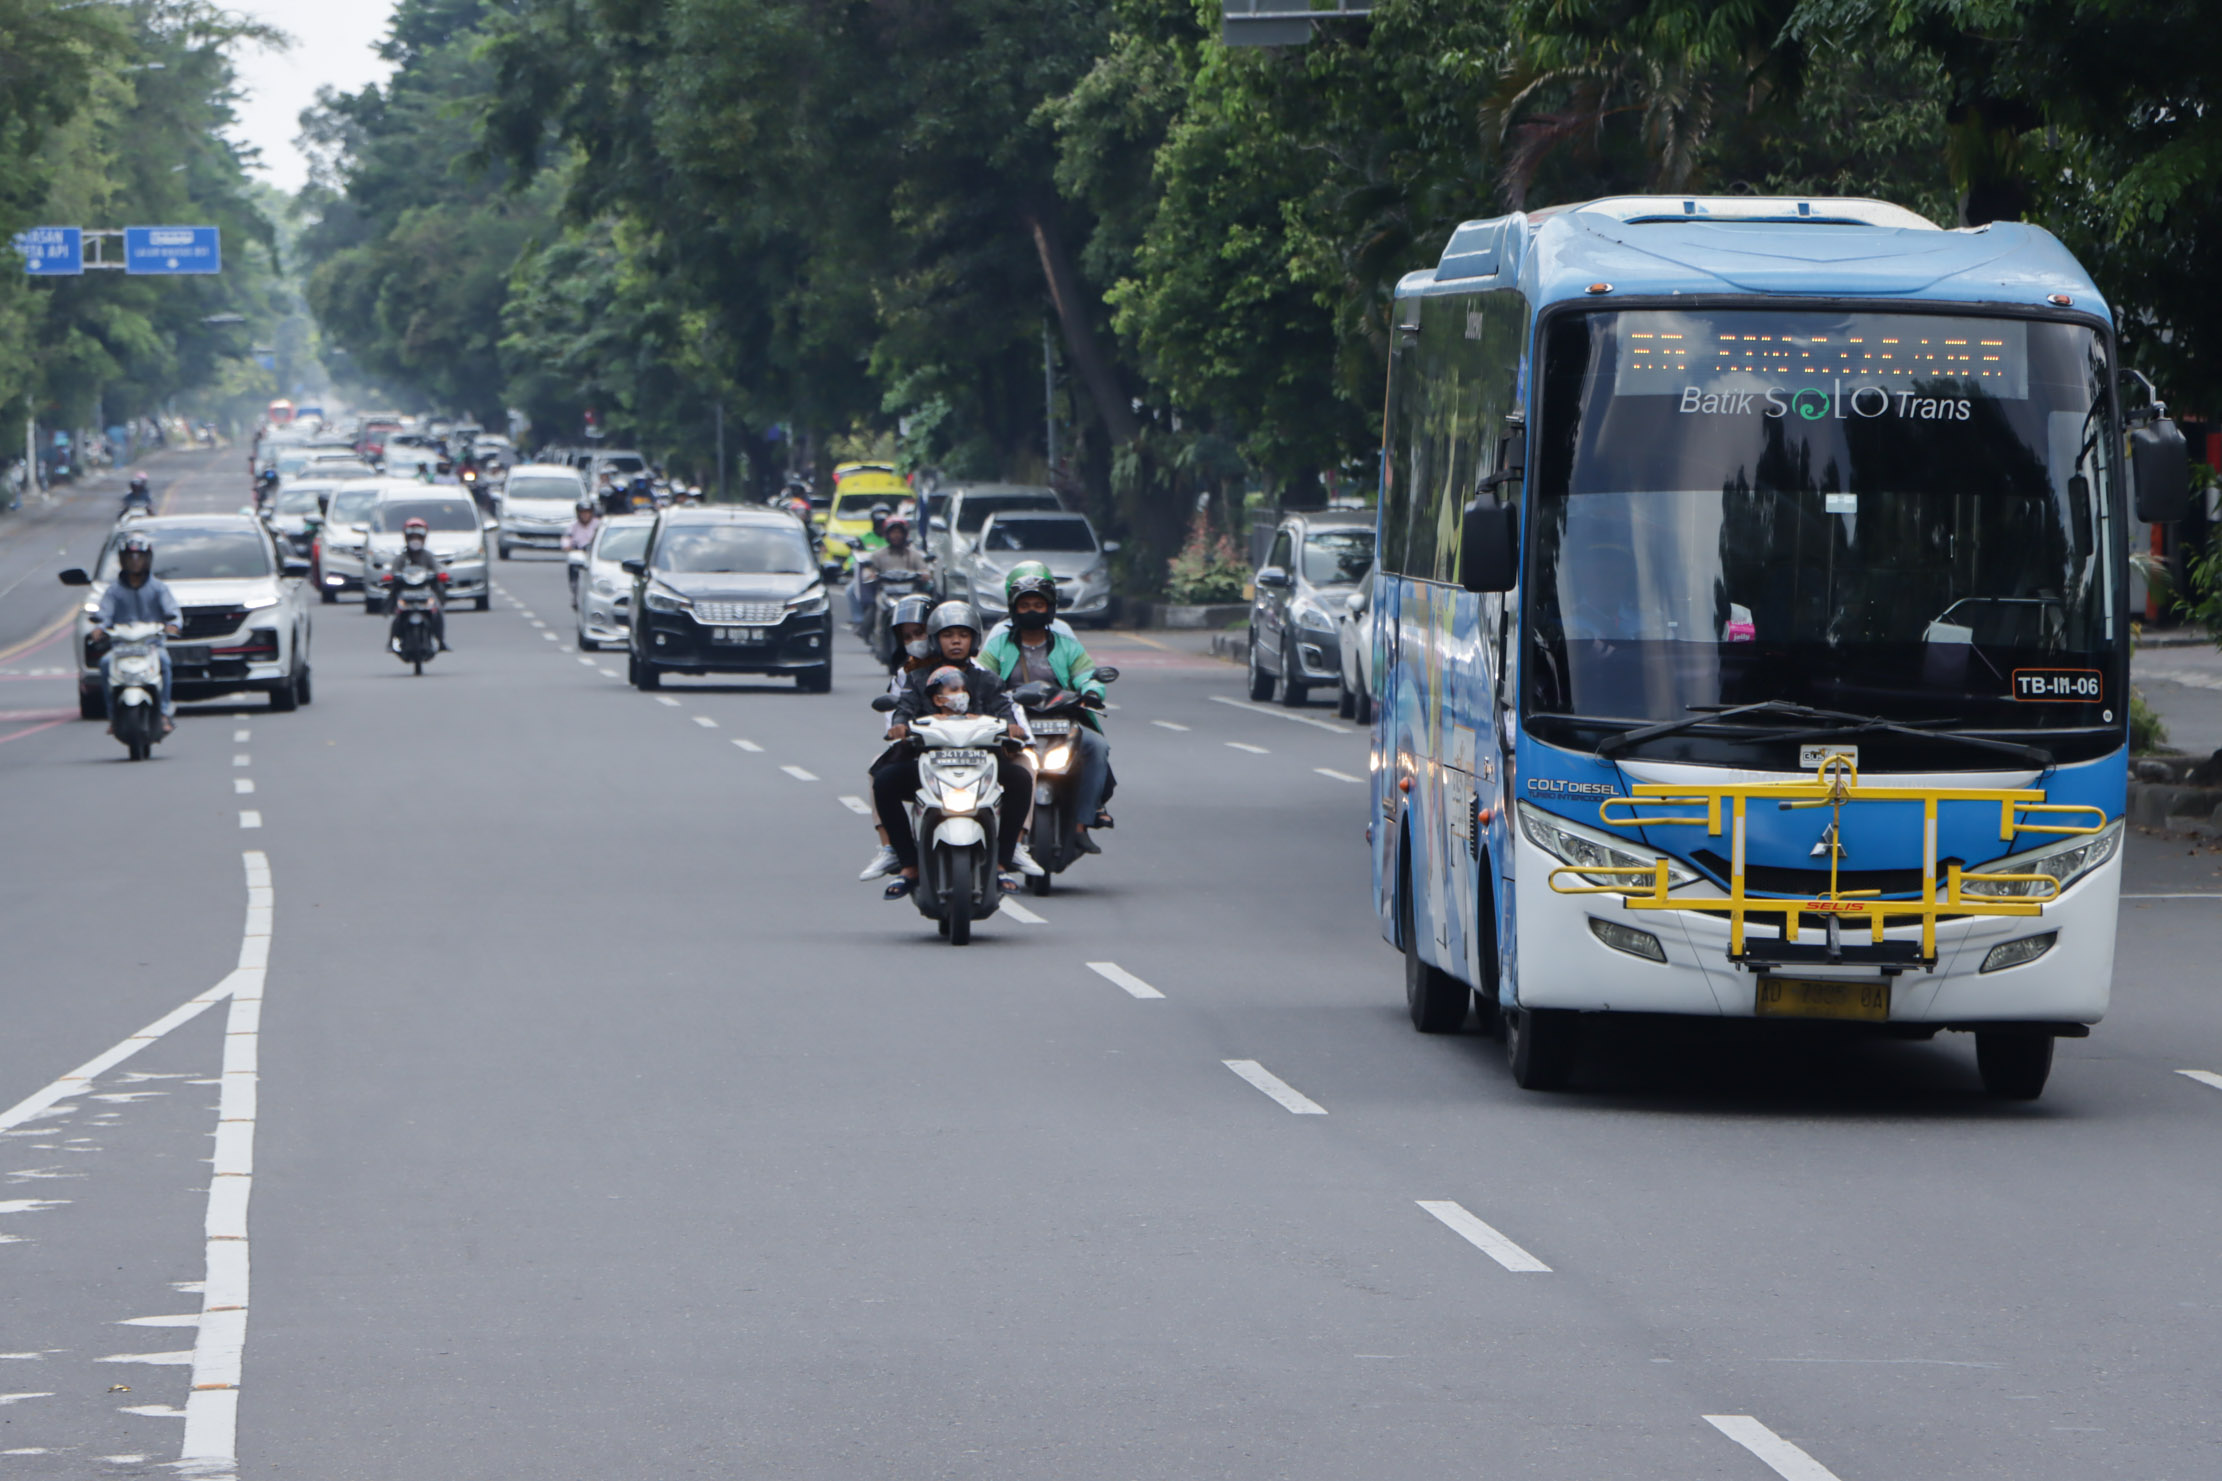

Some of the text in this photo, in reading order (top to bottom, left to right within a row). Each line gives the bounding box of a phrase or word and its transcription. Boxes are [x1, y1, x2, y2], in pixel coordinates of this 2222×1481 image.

[1679, 386, 1753, 415] Batik
[1896, 390, 1972, 421] Trans
[1562, 792, 1618, 802] INTERCOOL
[1804, 901, 1864, 911] SELIS
